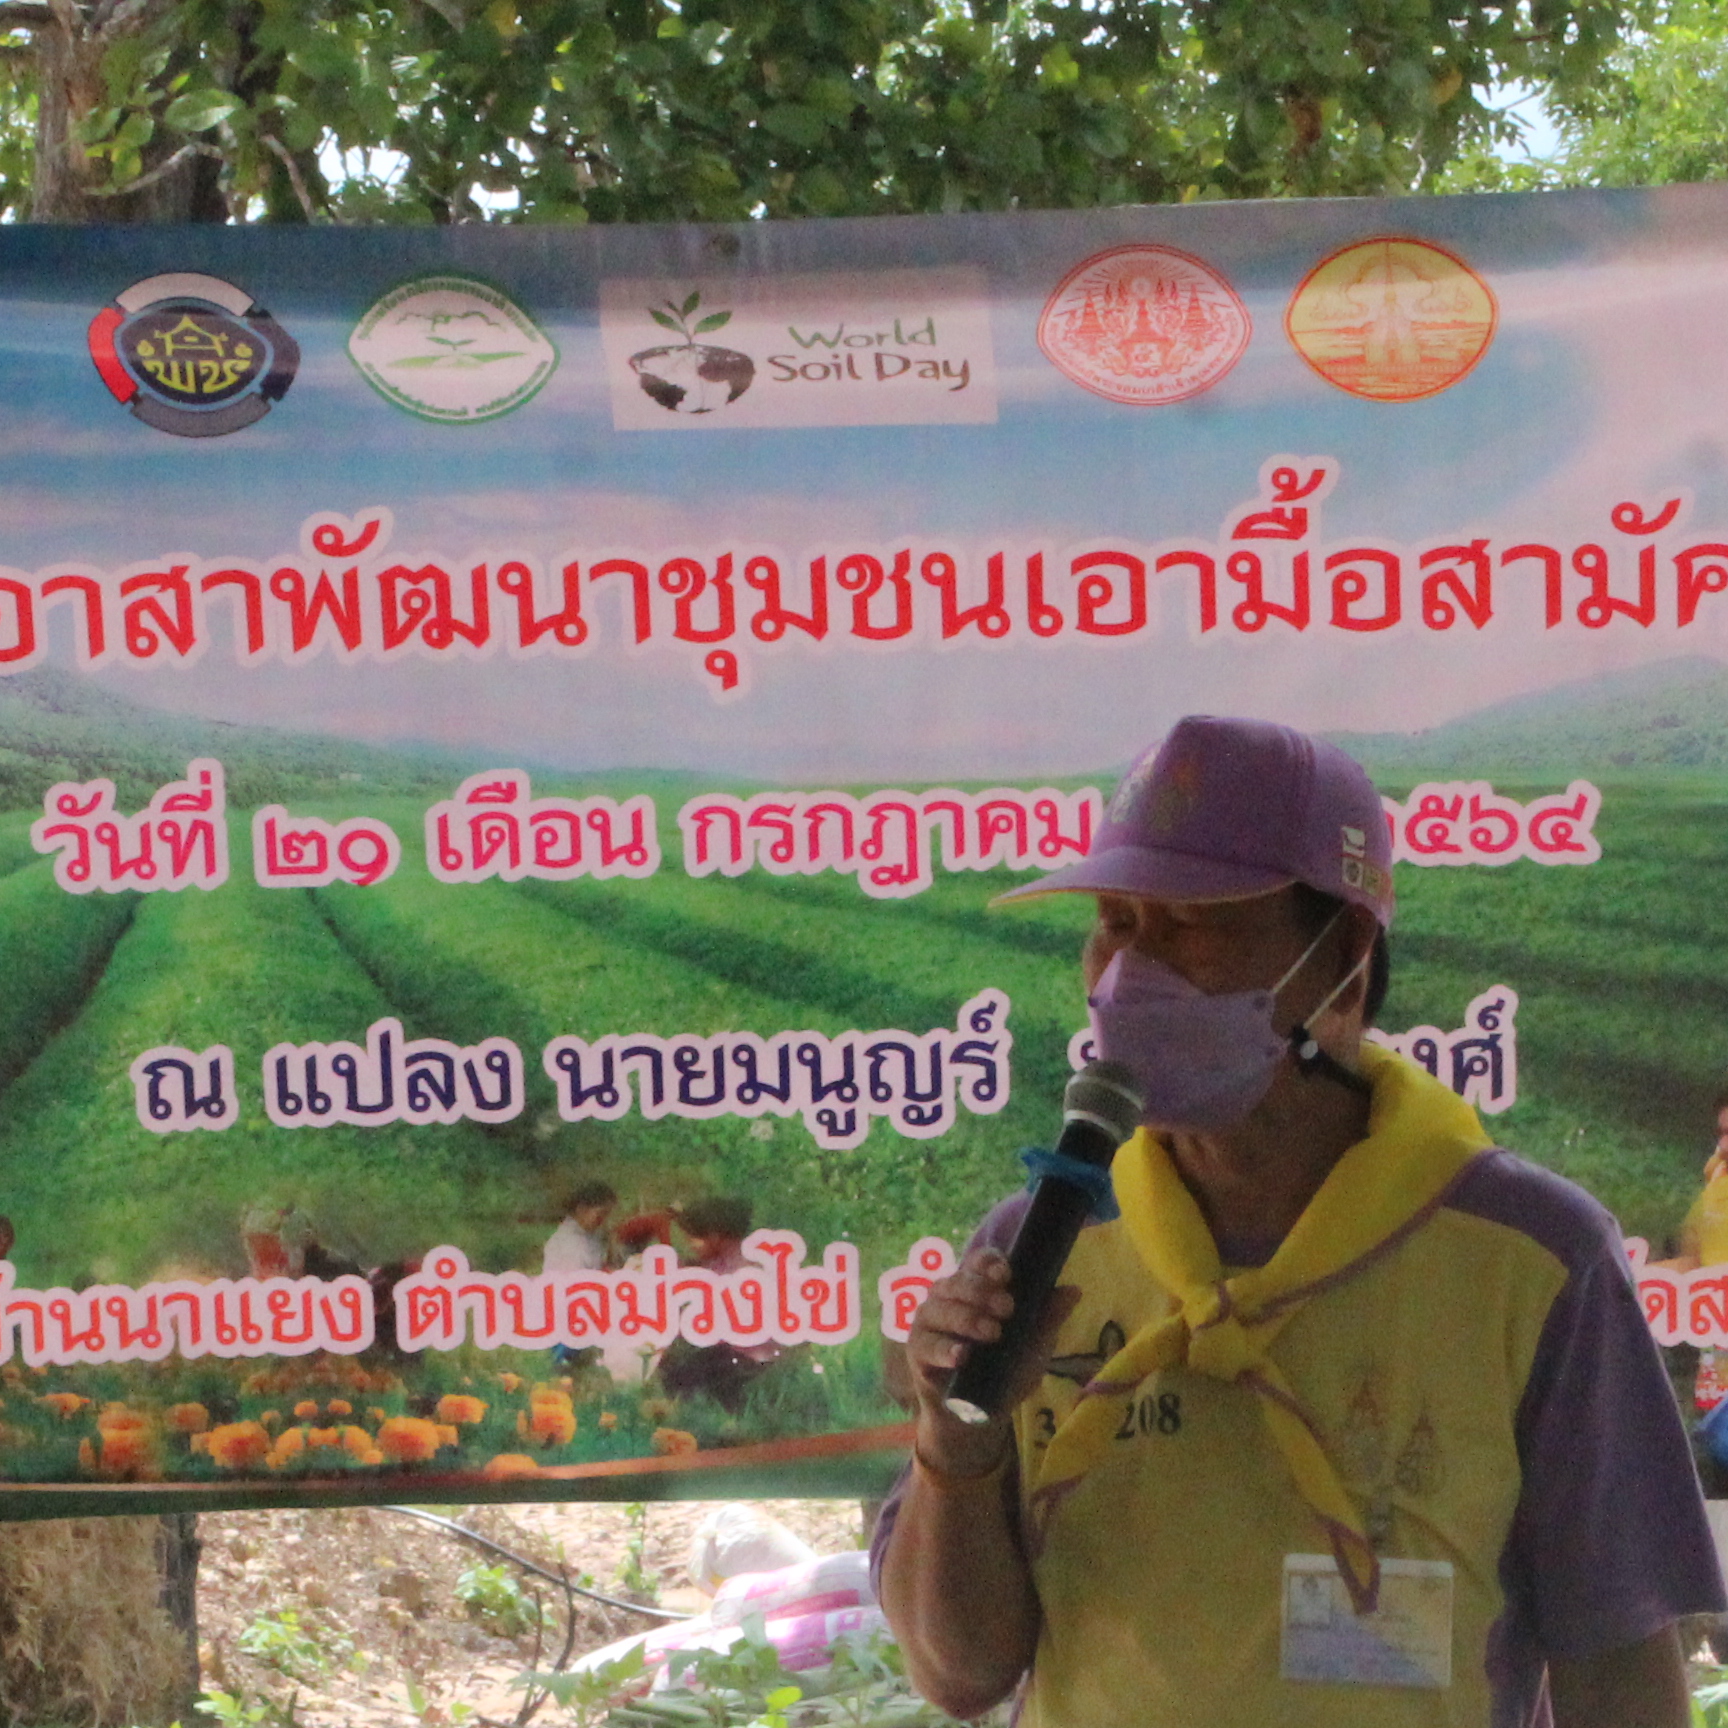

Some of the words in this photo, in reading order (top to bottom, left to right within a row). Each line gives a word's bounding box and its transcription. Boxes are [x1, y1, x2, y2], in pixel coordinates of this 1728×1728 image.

[766, 353, 863, 383] Soil
[874, 353, 971, 393] Day
[787, 317, 937, 350] World
[43, 770, 218, 883] วันที่
[265, 816, 391, 887] ๒๑
[436, 780, 650, 872] เดือน
[690, 797, 1090, 886] กรกฎาคม
[1385, 791, 1589, 855] ๕๖๔
[142, 1058, 227, 1120] ณ
[275, 1030, 513, 1117] แปลง
[556, 1001, 1009, 1137] นายมนูญร์
[405, 1235, 850, 1340] ตำบลม่วงไข่
